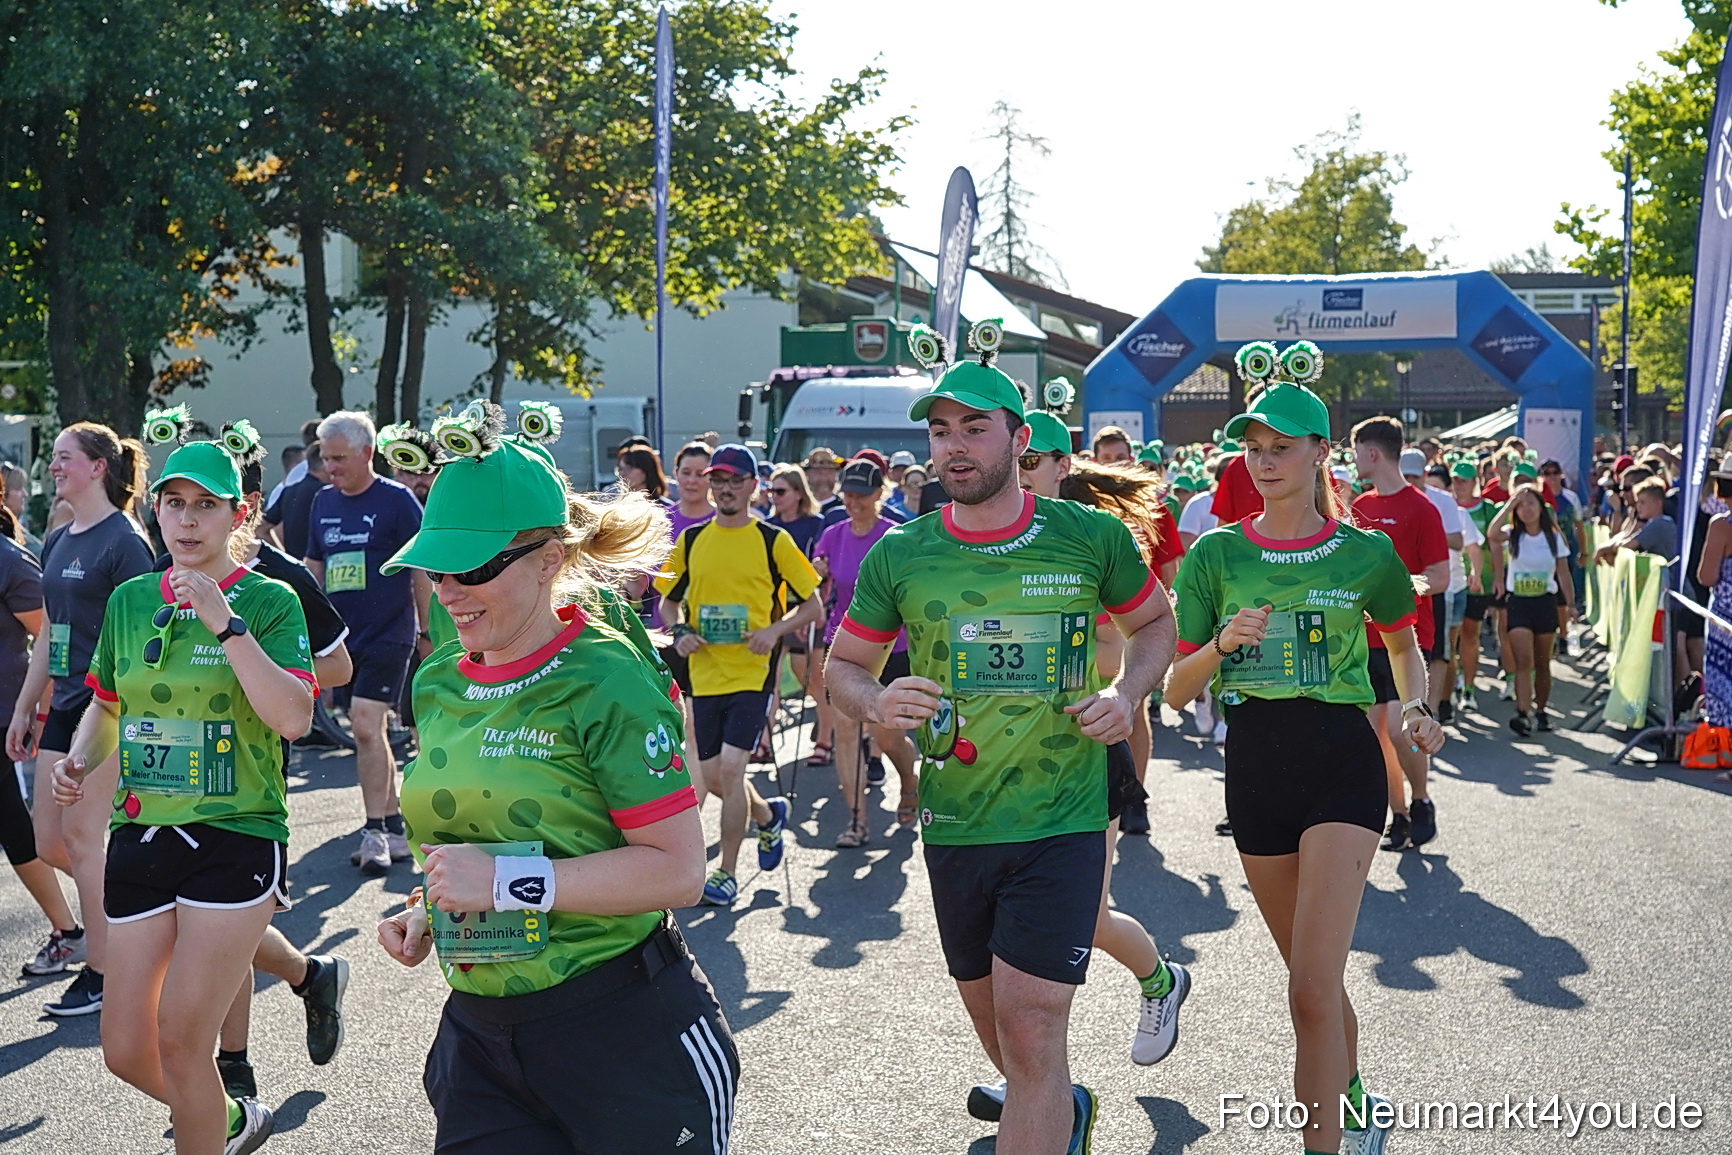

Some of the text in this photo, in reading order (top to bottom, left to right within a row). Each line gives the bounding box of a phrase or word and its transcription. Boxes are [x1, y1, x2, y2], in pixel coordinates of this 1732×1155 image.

[1308, 309, 1397, 329] firmenlauf
[1021, 574, 1082, 585] TRENDHAUS
[1022, 586, 1081, 597] POWER-TEAM
[705, 618, 738, 632] 1251
[979, 629, 1013, 637] Firmenlauf
[988, 643, 1025, 670] 33
[1230, 643, 1264, 665] 34
[1283, 641, 1294, 677] 2022
[957, 651, 968, 679] RUN
[1046, 646, 1056, 683] 2022
[1252, 664, 1284, 673] Katharina
[976, 671, 1038, 682] Finck Marco
[122, 750, 130, 776] RUN
[142, 743, 171, 770] 37
[131, 769, 185, 782] Meier Theresa
[189, 750, 199, 786] 2022
[433, 927, 525, 940] Daume Dominika
[675, 1132, 696, 1147] adidas
